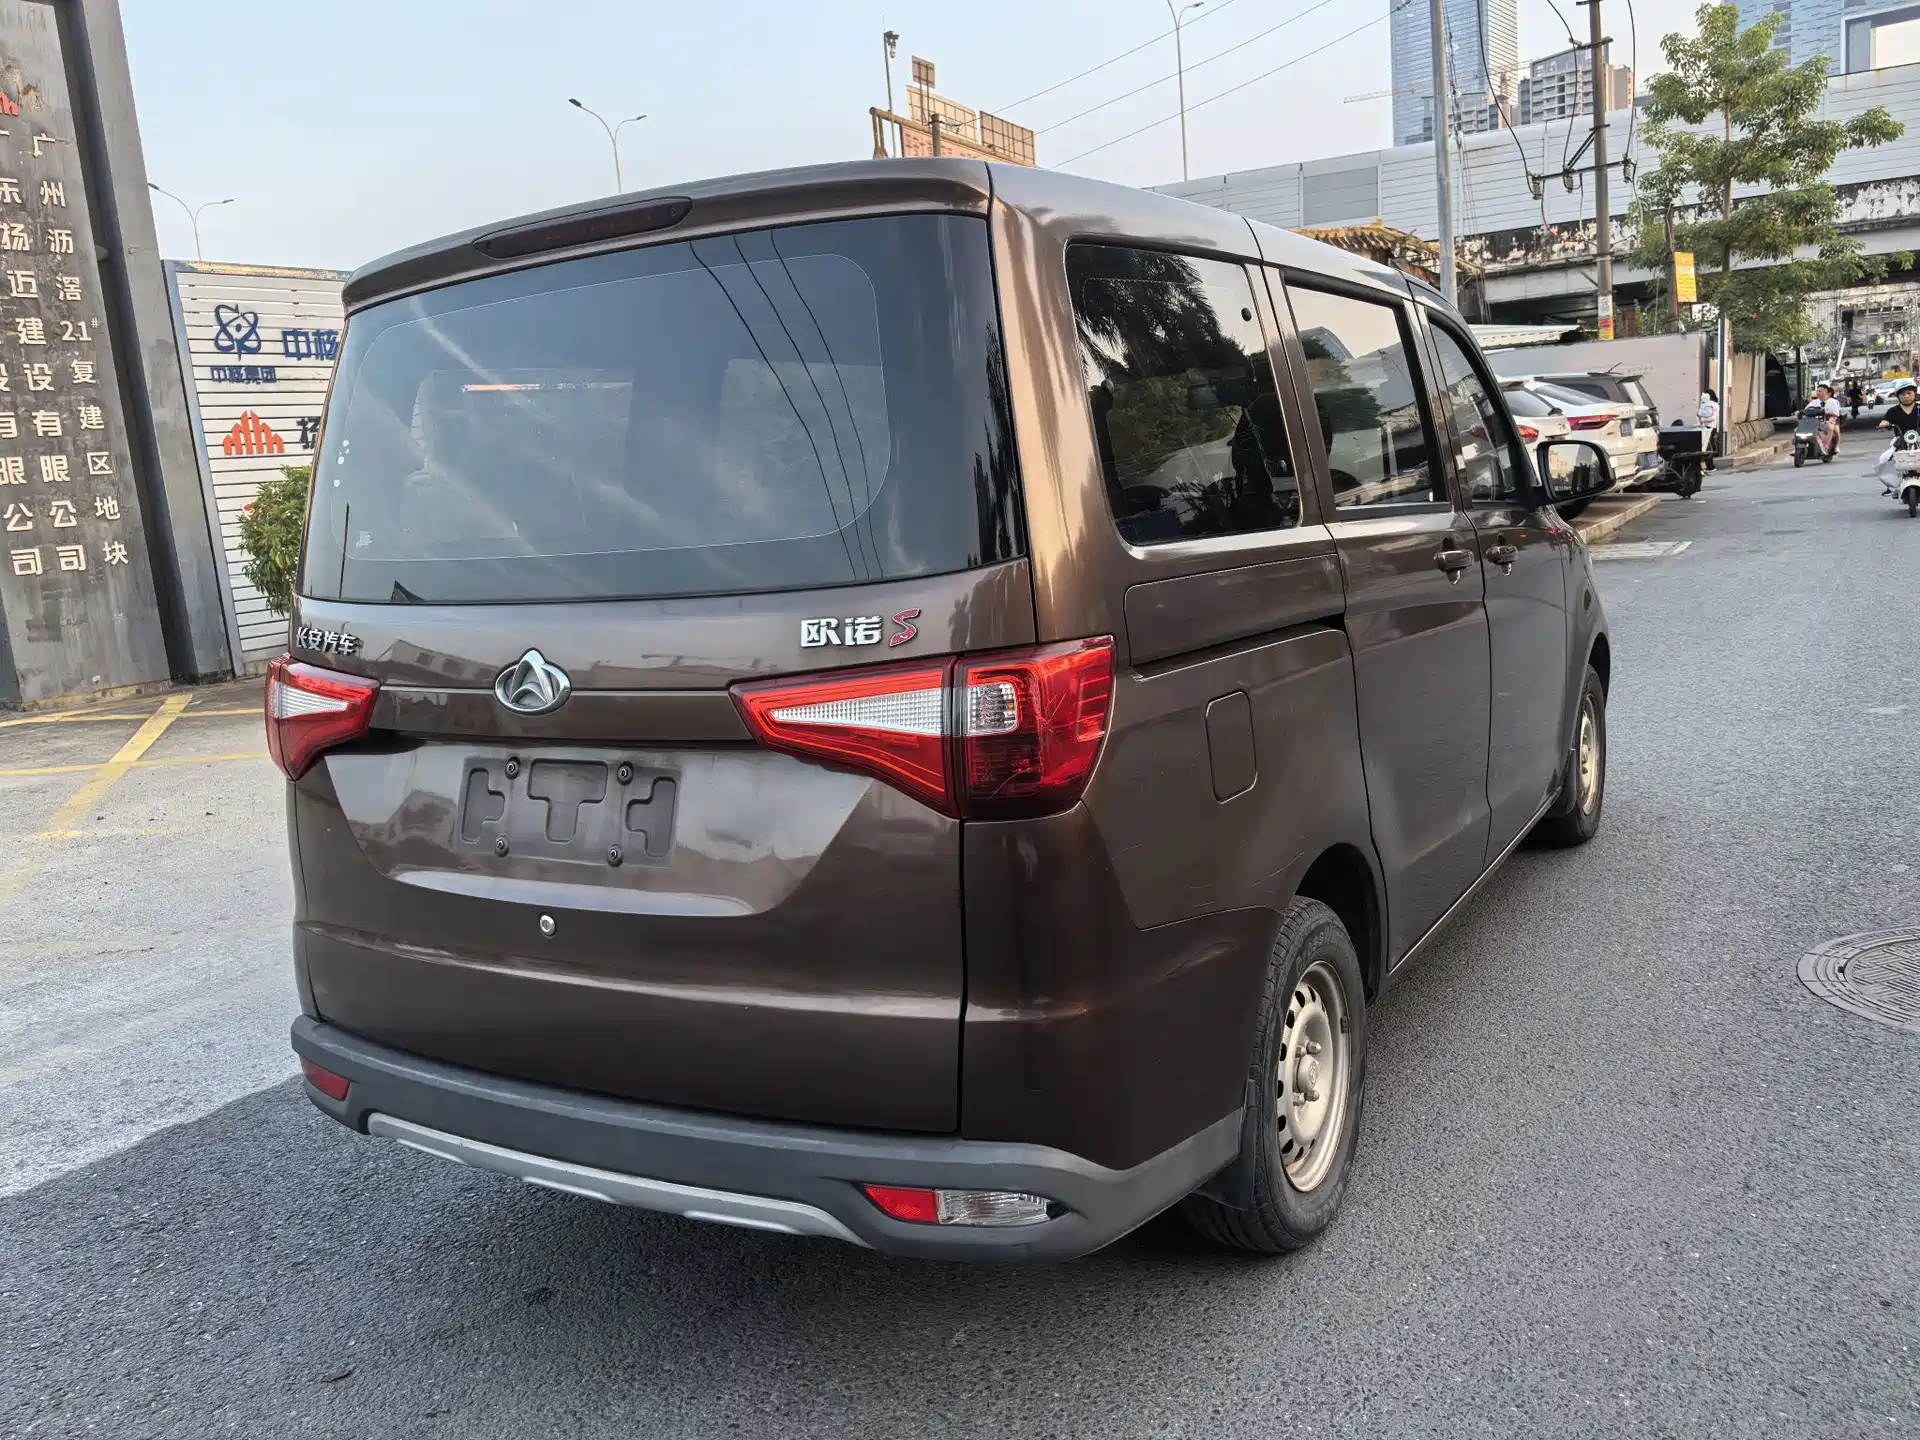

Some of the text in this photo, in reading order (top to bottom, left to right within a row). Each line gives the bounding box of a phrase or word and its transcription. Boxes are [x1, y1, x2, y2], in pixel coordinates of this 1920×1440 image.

[0, 130, 86, 572] 东扬迈建设有限公司
[296, 626, 356, 656] 长安汽车
[801, 607, 920, 648] 欧诺 S
